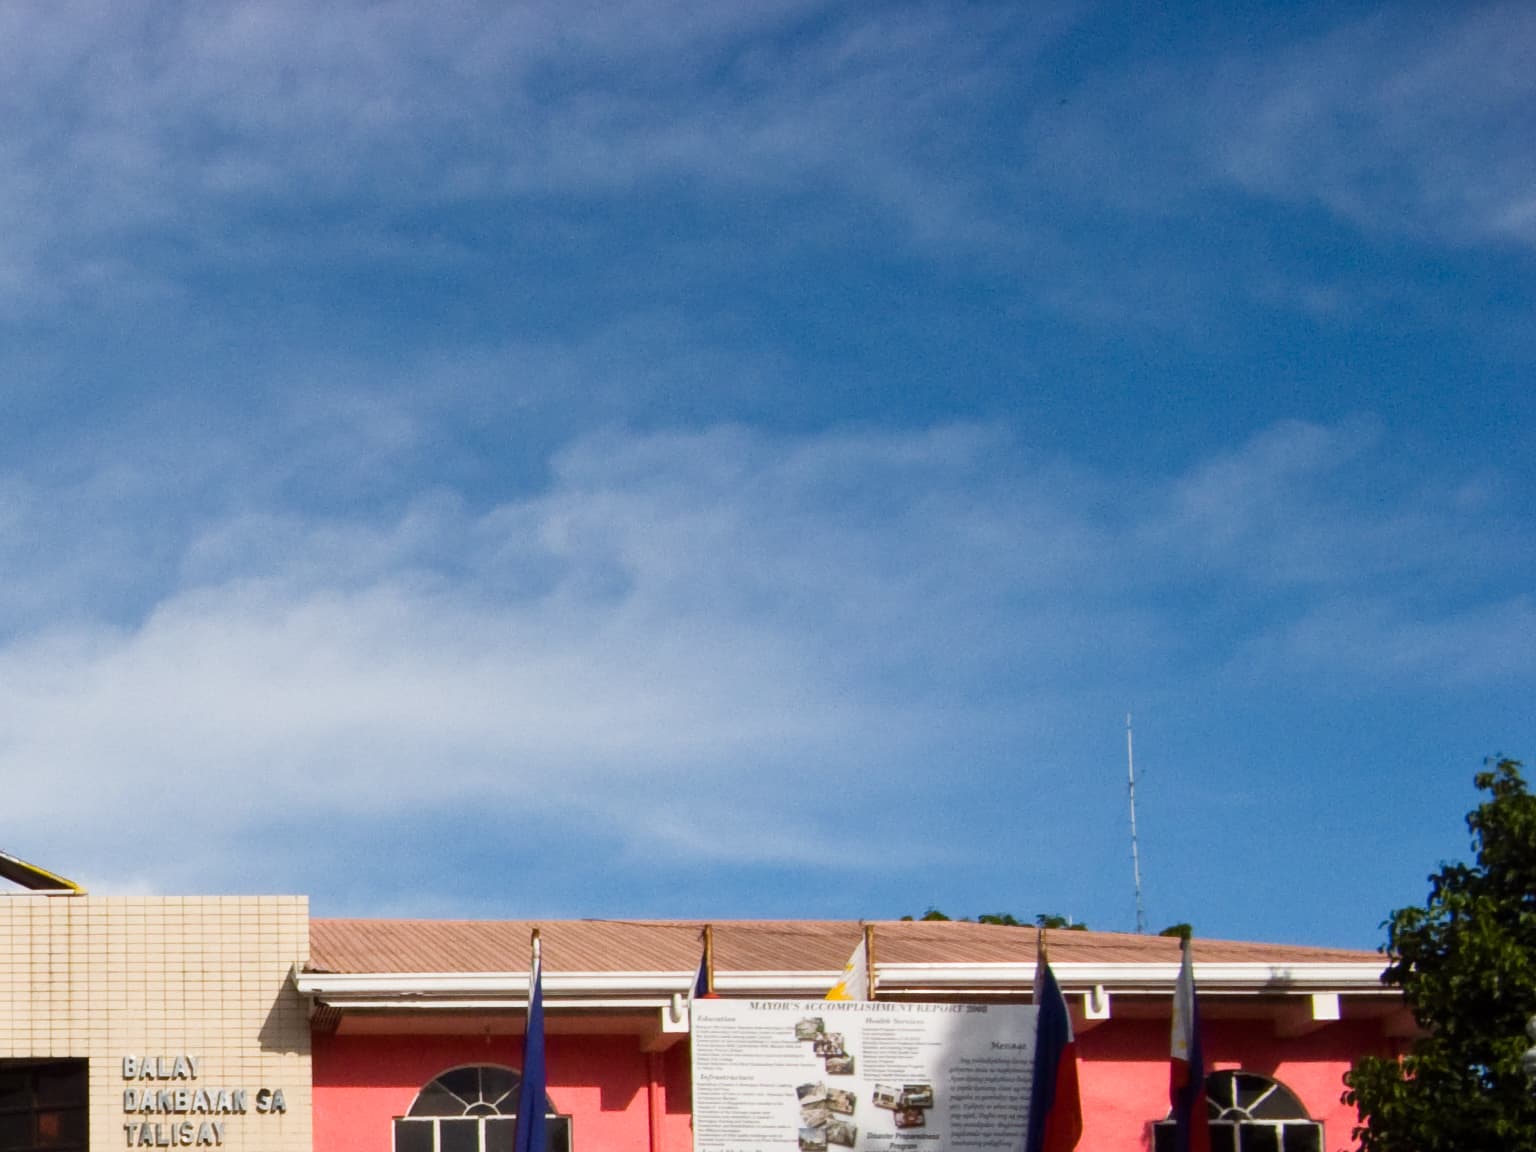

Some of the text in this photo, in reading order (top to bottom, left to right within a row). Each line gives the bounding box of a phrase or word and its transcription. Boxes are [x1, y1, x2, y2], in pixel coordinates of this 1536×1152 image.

[123, 1056, 199, 1080] BALAY
[123, 1088, 286, 1114] DAKBAYAN SA
[123, 1121, 225, 1147] TALISAY
